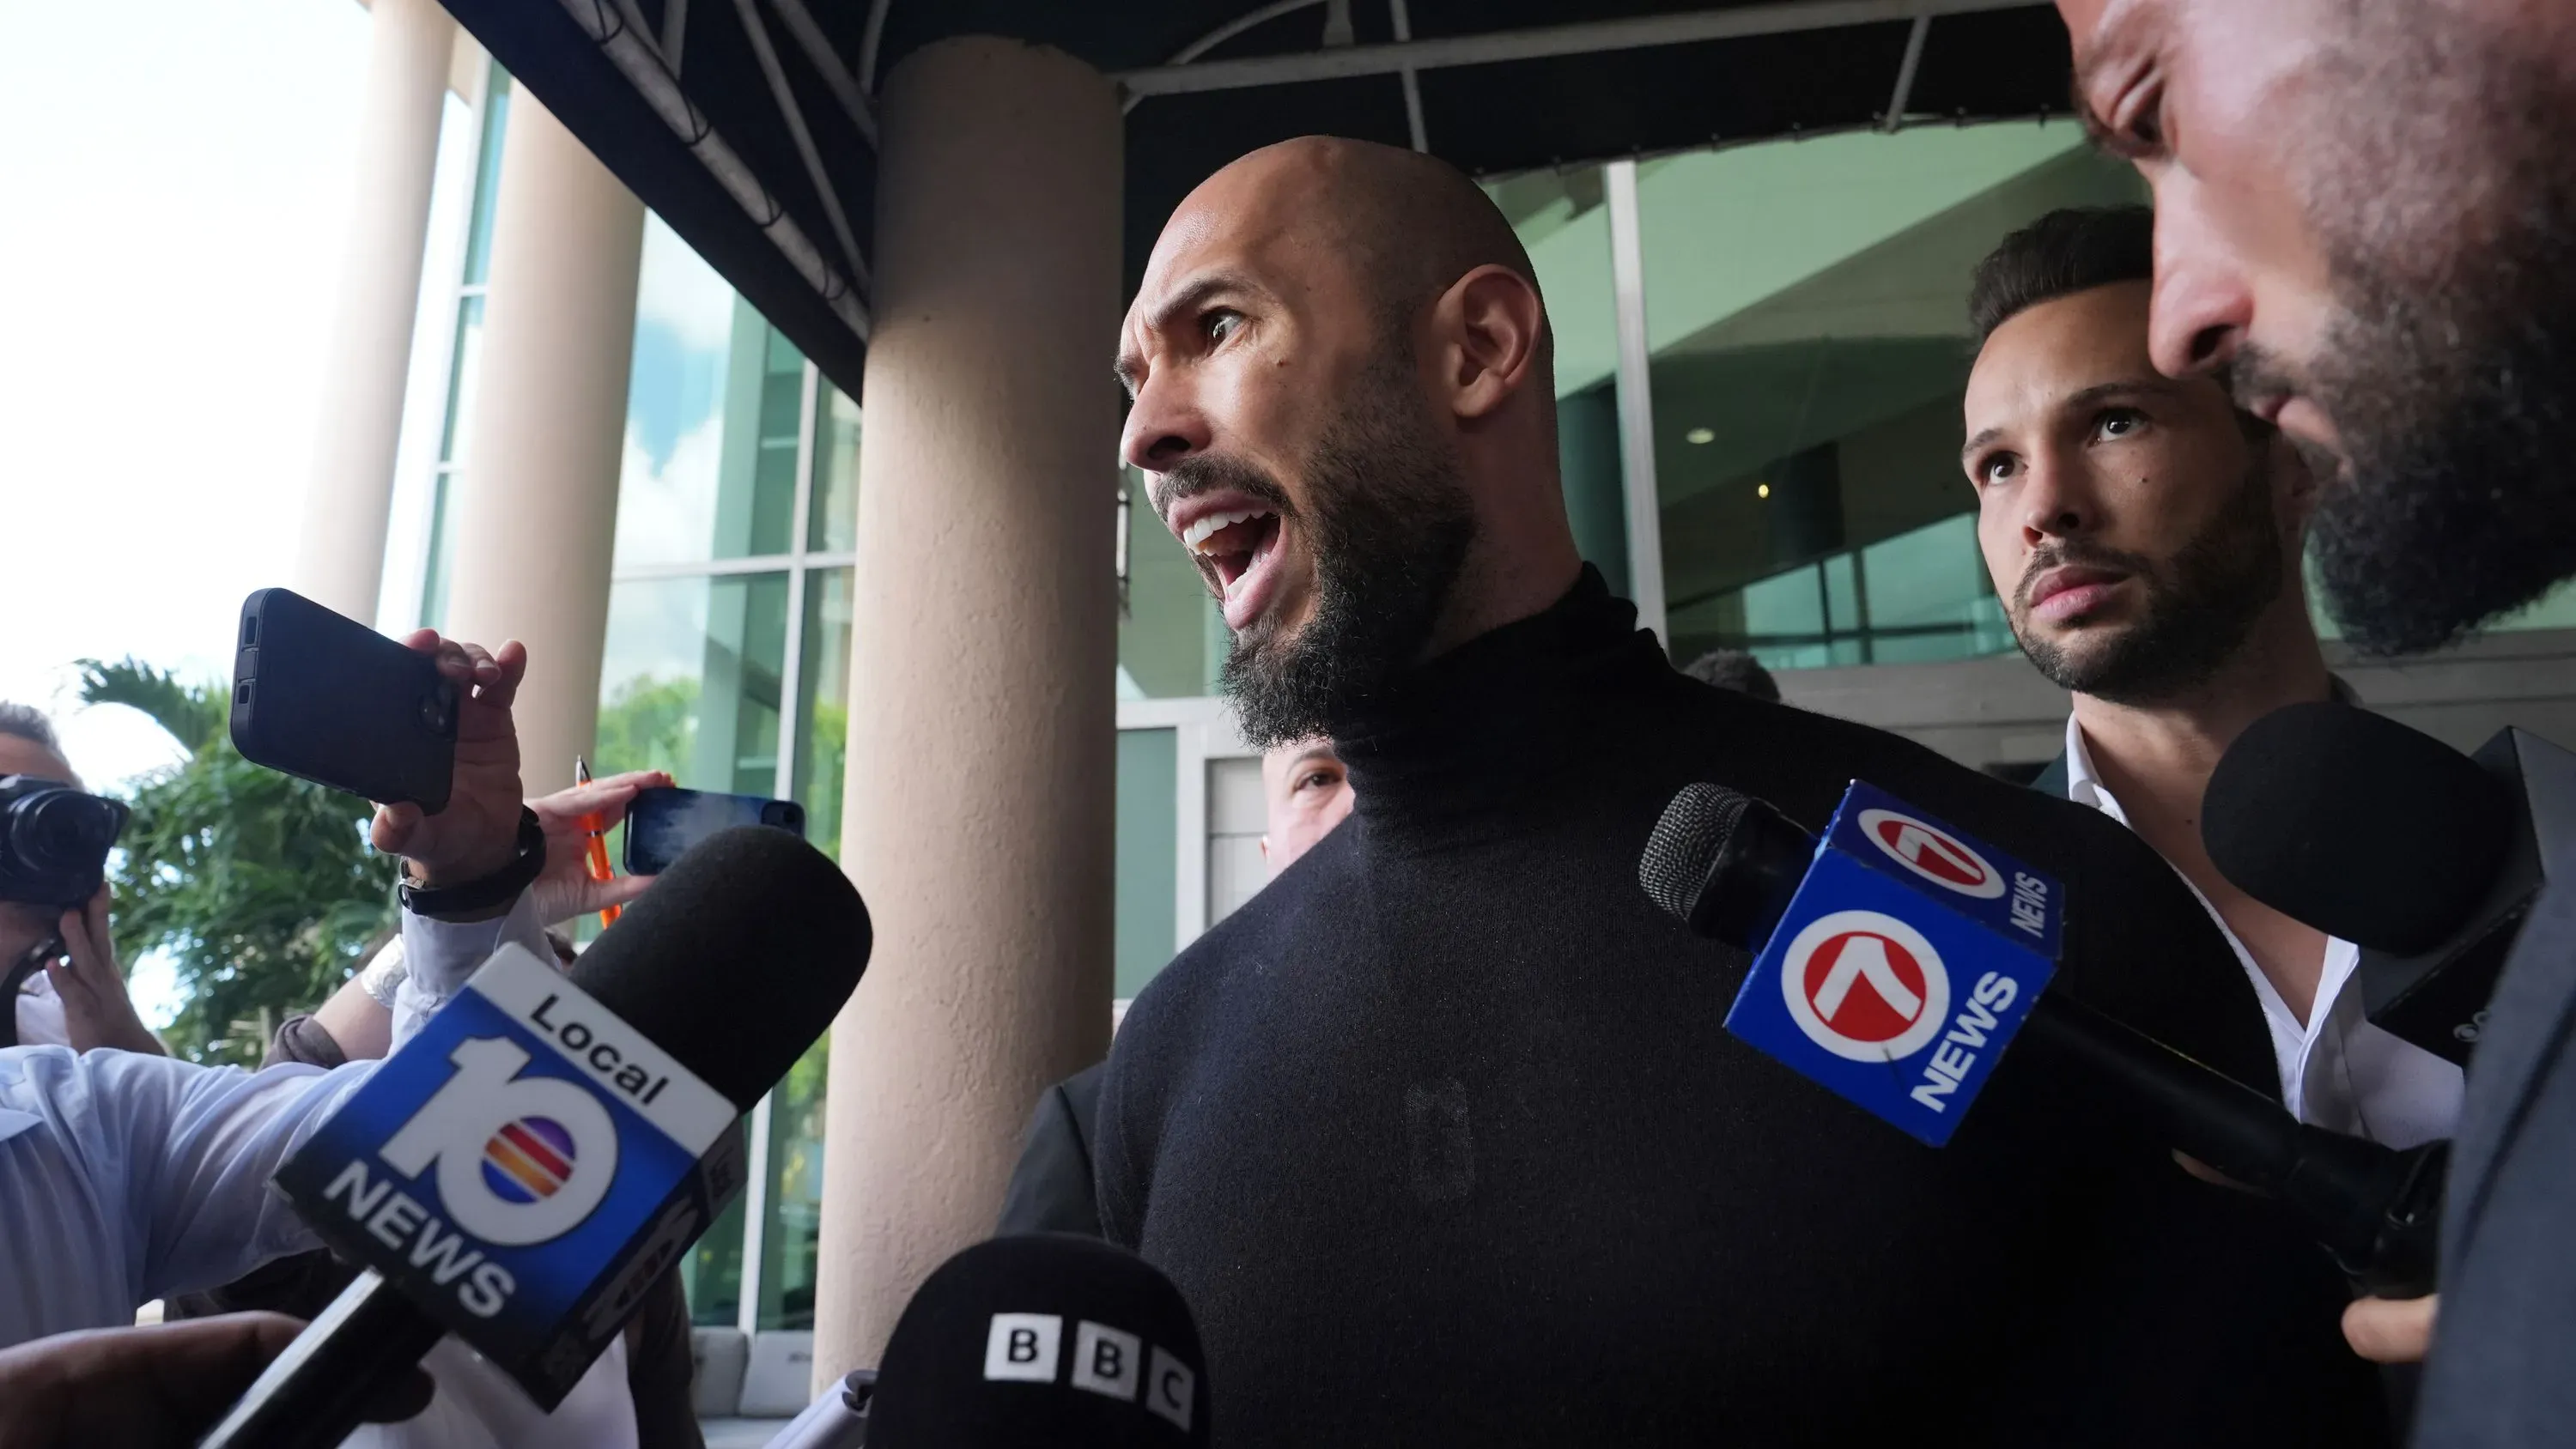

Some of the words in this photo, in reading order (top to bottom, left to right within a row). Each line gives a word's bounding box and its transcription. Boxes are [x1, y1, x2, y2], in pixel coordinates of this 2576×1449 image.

[1897, 824, 1983, 882] 7
[2010, 871, 2049, 939] NEWS
[1812, 936, 1923, 1023] 7
[529, 993, 669, 1106] Local
[1910, 970, 2019, 1113] NEWS
[378, 1034, 618, 1246] 10
[323, 1159, 515, 1319] NEWS
[1006, 1328, 1185, 1411] BBC
